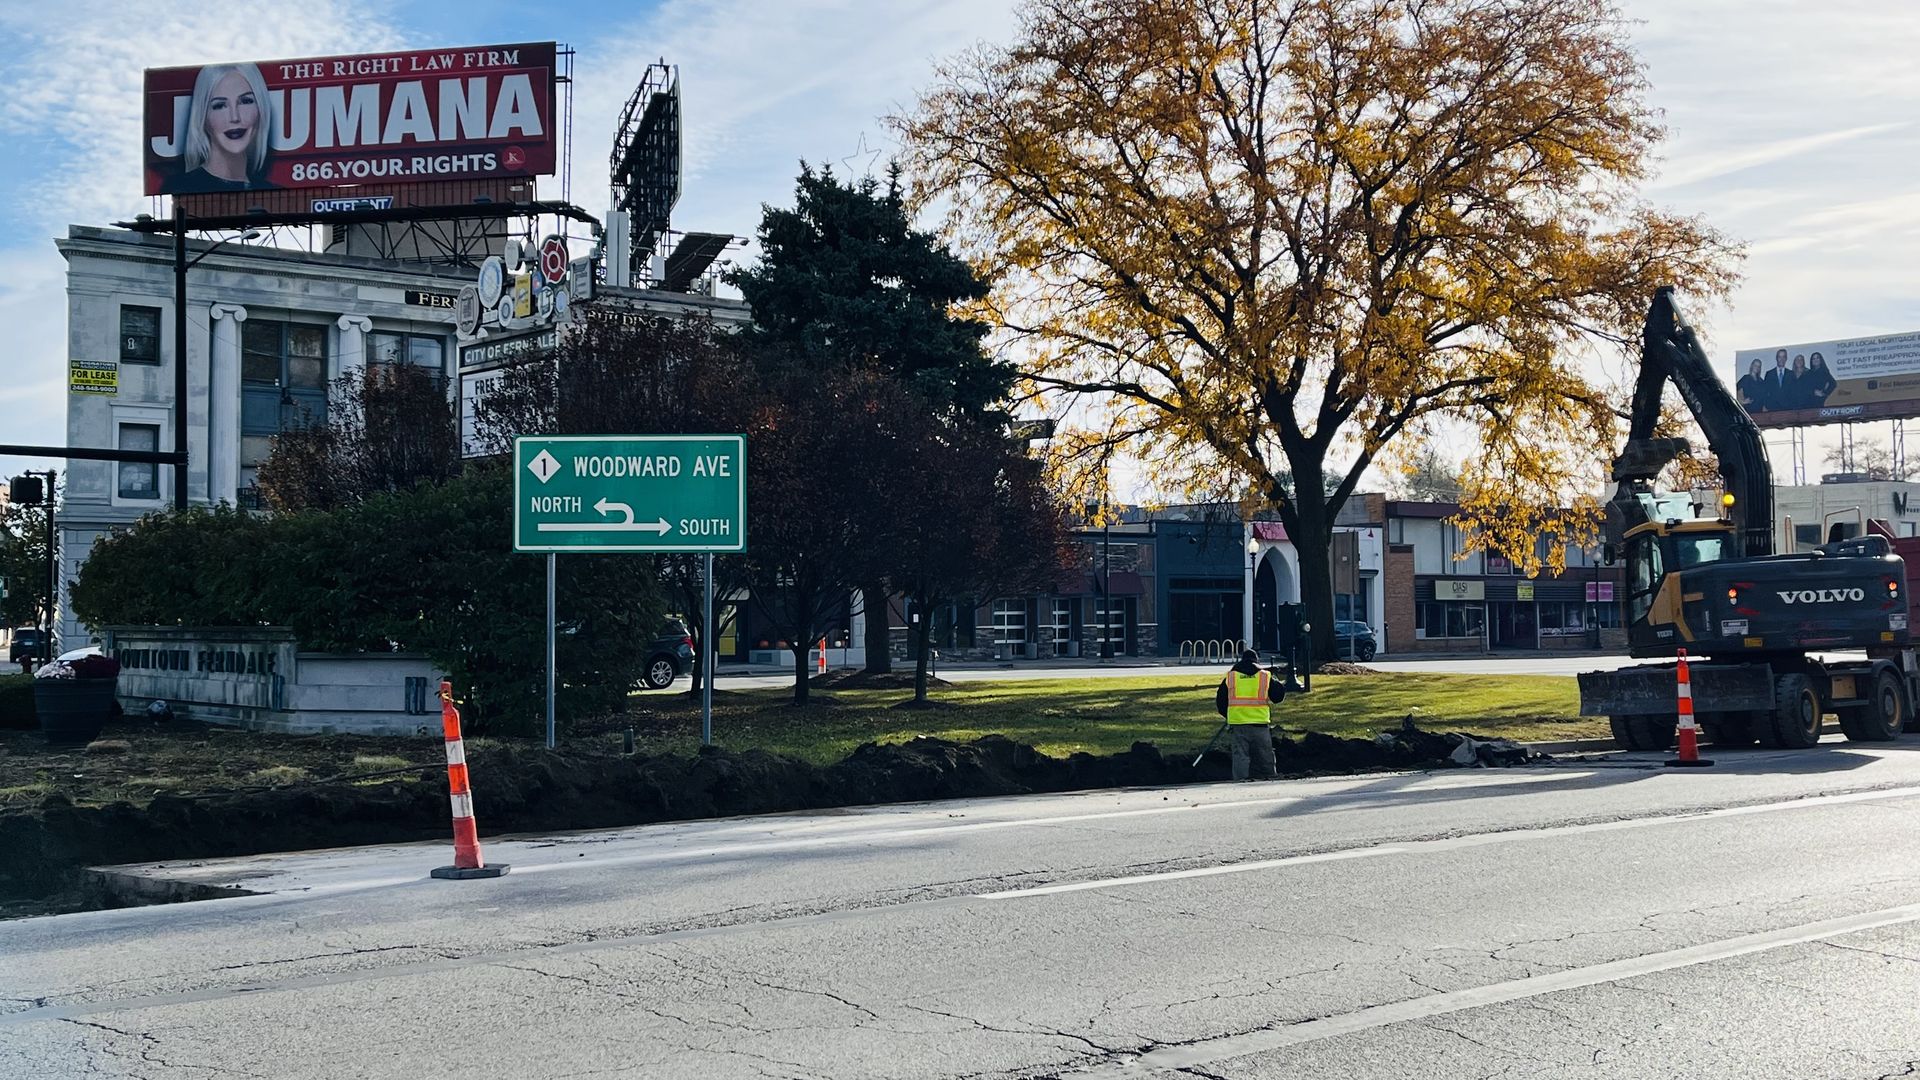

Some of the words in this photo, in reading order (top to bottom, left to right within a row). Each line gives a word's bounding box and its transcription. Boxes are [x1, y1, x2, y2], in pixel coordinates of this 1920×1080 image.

[280, 63, 325, 80] THE
[332, 57, 402, 77] RIGHT
[410, 53, 456, 71] LAW
[463, 50, 520, 68] FIRM
[151, 73, 543, 157] JUMANA
[291, 153, 497, 181] 866.YOUR.RIGHTS
[314, 198, 388, 213] OUTFRNT
[465, 348, 486, 363] CITY
[487, 344, 501, 359] OF
[503, 333, 555, 356] FERNALE
[1873, 350, 1920, 361] PREAPPROV
[72, 370, 88, 378] FOR
[90, 371, 116, 380] LEASE
[541, 458, 547, 477] 1
[574, 456, 681, 477] WOODWARD
[693, 455, 731, 477] AVE
[531, 496, 582, 513] NORTH
[679, 518, 730, 536] SOUTH
[1776, 588, 1865, 604] VOLVO
